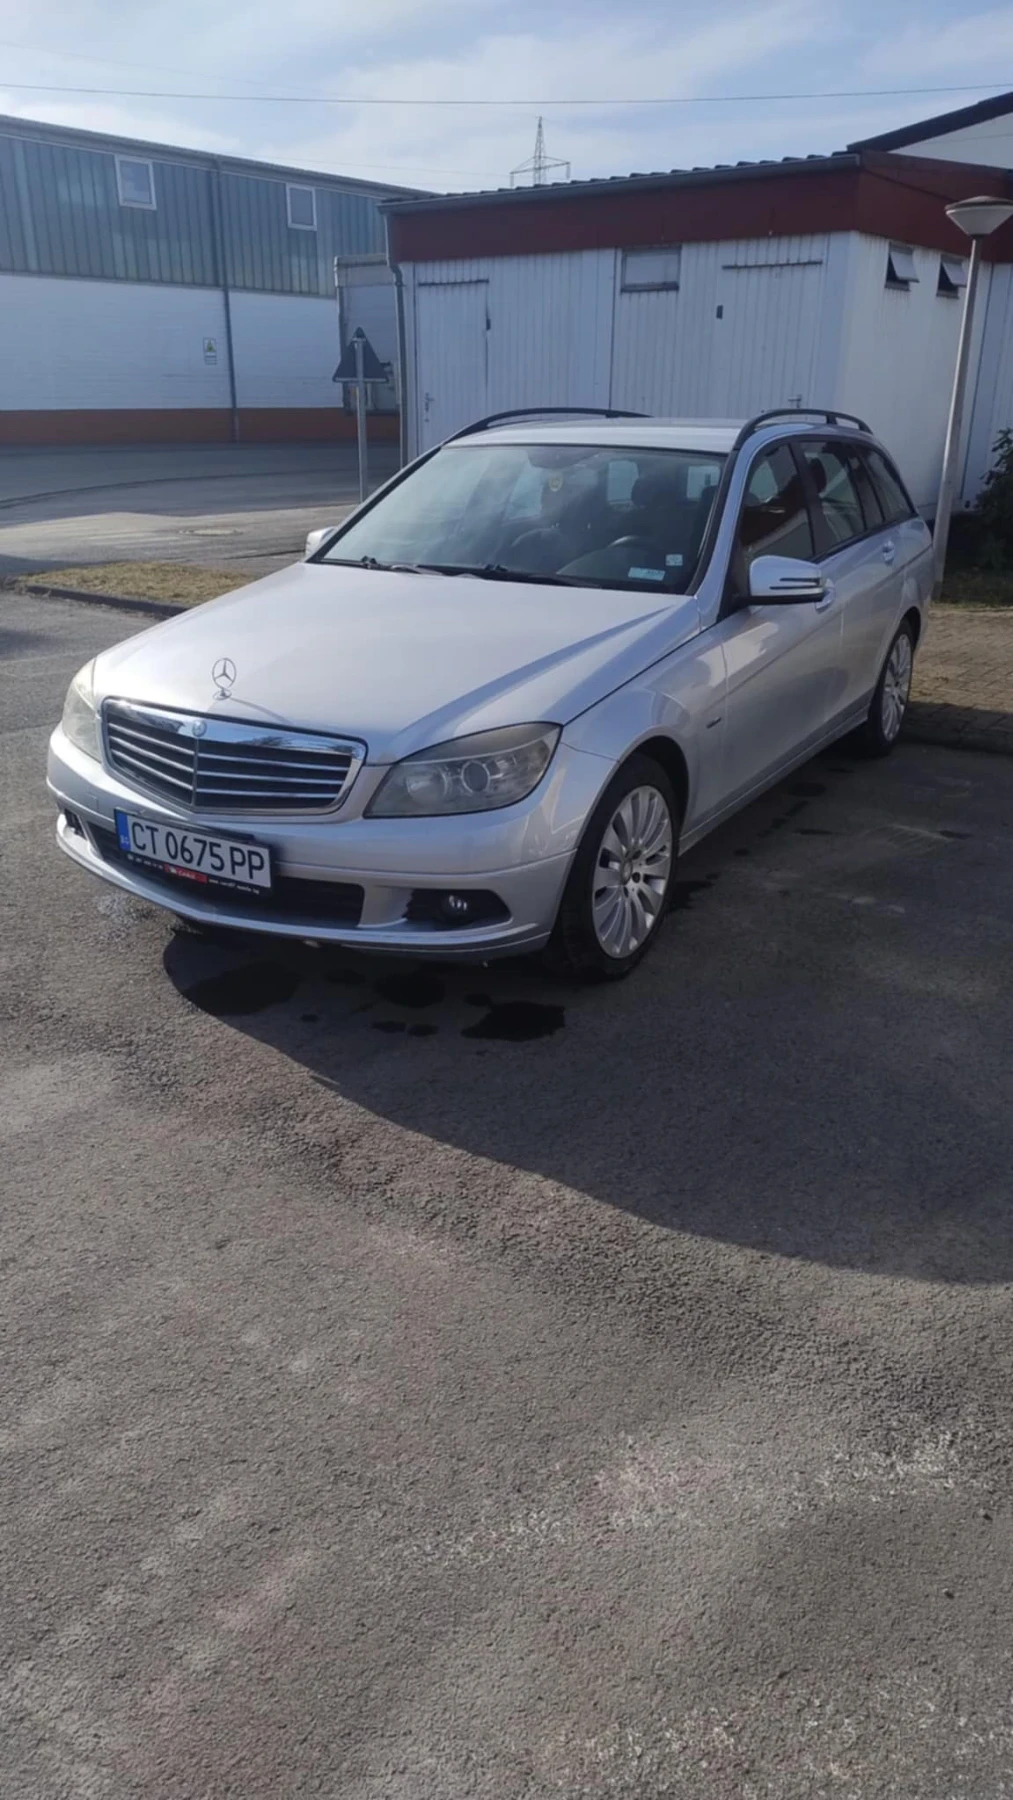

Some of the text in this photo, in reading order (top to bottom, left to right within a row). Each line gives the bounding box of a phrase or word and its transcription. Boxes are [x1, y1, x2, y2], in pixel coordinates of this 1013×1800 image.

[131, 822, 159, 855] CT
[165, 831, 225, 872] 0675
[229, 846, 264, 879] PP
